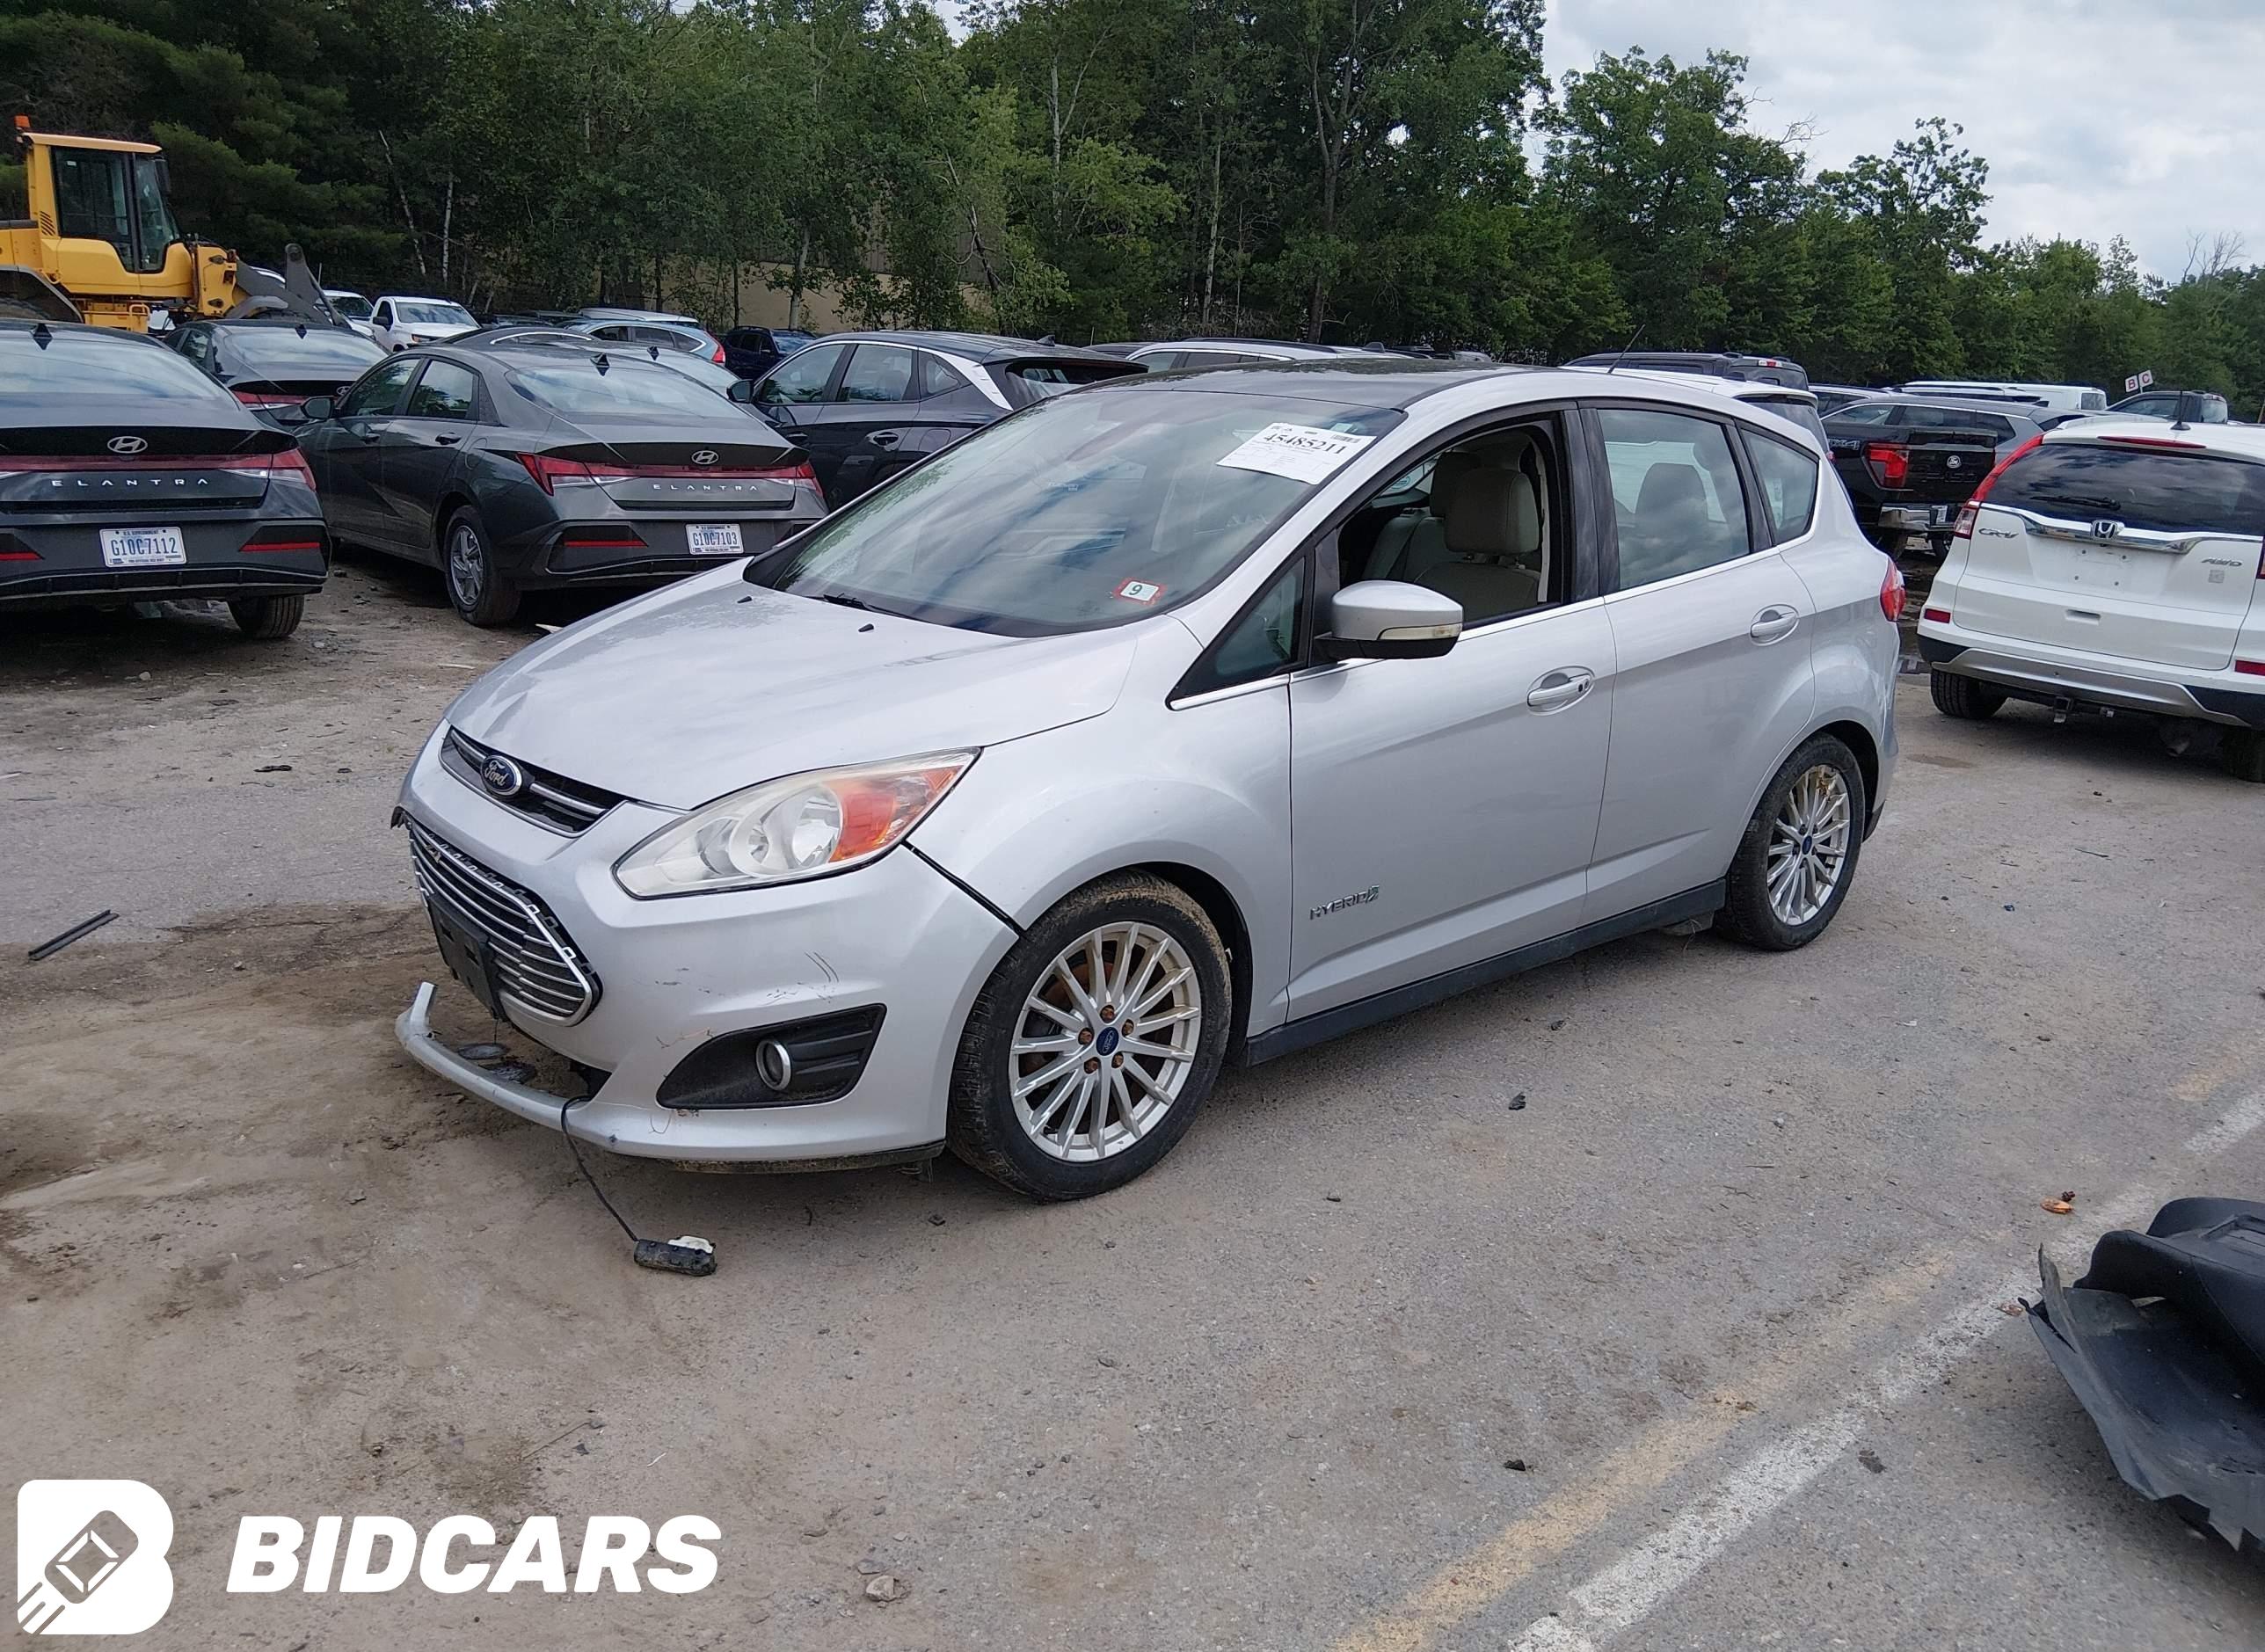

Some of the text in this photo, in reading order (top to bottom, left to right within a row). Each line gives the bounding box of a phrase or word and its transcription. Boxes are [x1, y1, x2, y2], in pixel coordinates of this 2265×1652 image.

[2128, 378, 2136, 389] B
[2142, 373, 2151, 384] C
[692, 532, 738, 546] G10C7103
[111, 537, 178, 556] G10C7112
[1128, 584, 1143, 596] 9
[484, 760, 510, 787] Ford
[1309, 890, 1368, 921] HYBRID
